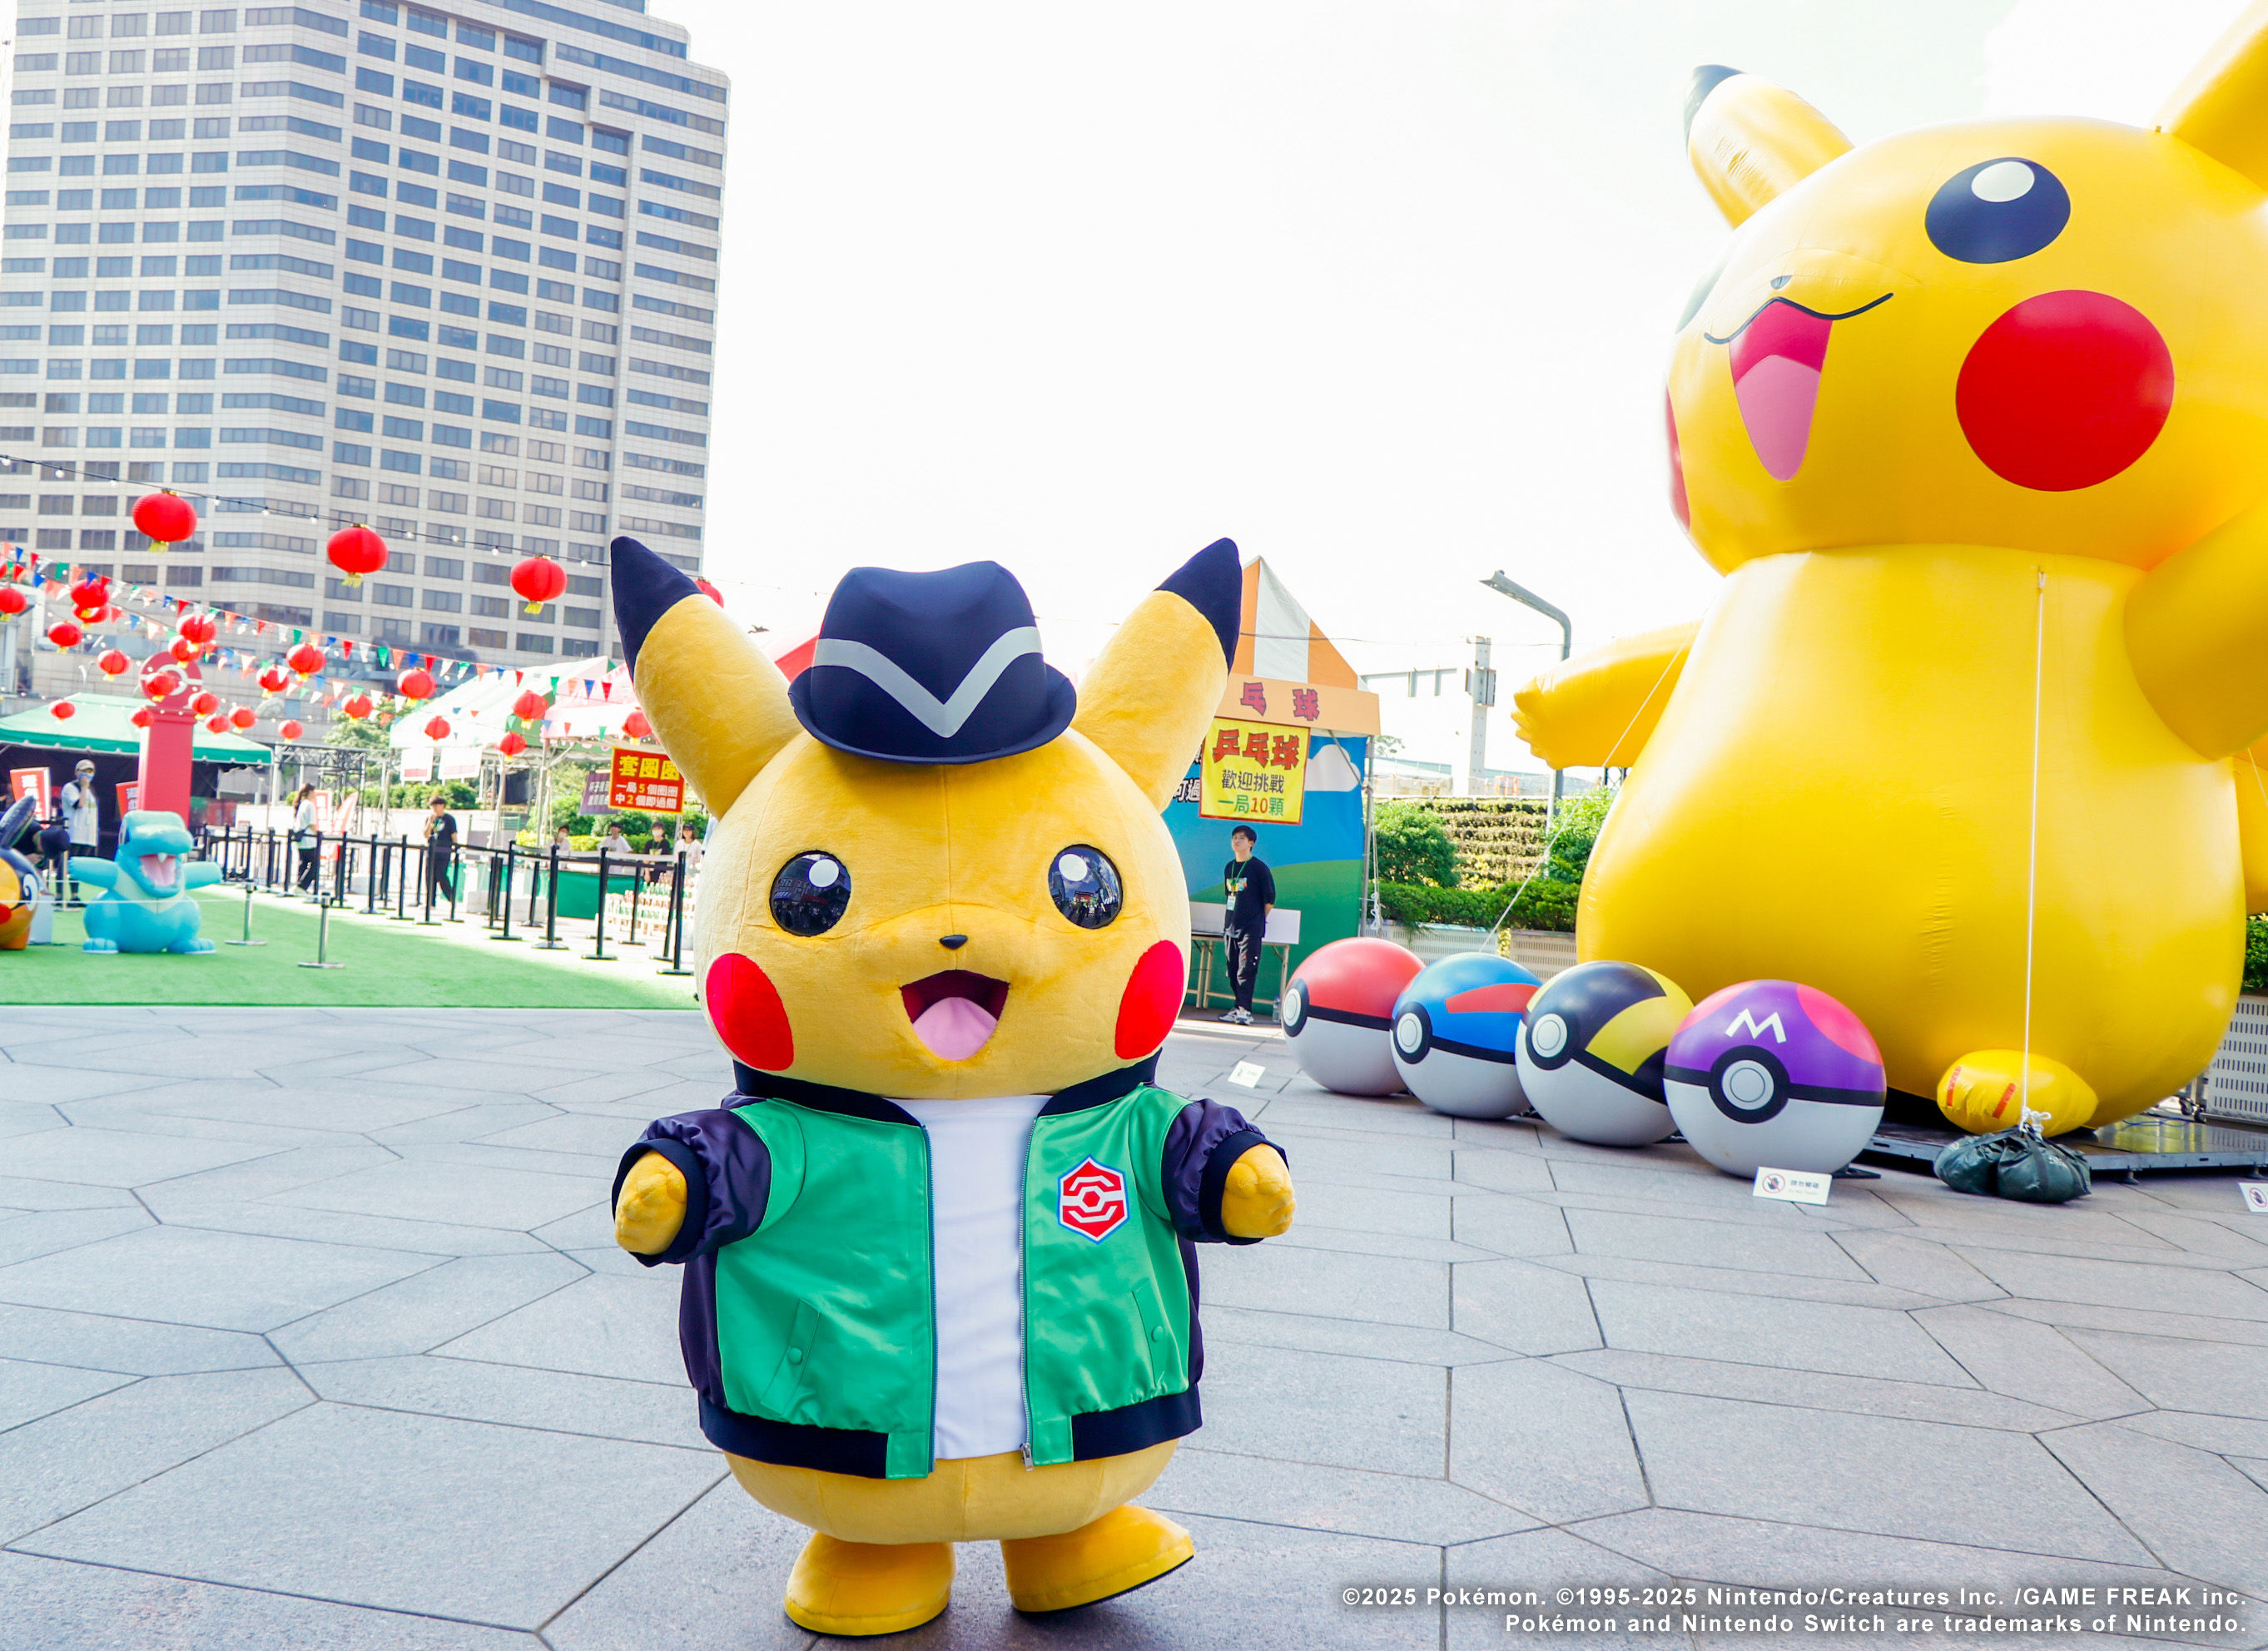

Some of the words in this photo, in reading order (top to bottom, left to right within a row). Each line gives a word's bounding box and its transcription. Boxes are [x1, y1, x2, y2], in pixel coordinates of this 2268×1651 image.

[1213, 729, 1301, 771] 乒乓球
[618, 755, 680, 781] 套圈圈
[1221, 769, 1284, 794] 歡迎挑戰
[1218, 794, 1284, 816] 一局10顆
[1725, 1008, 1787, 1044] M
